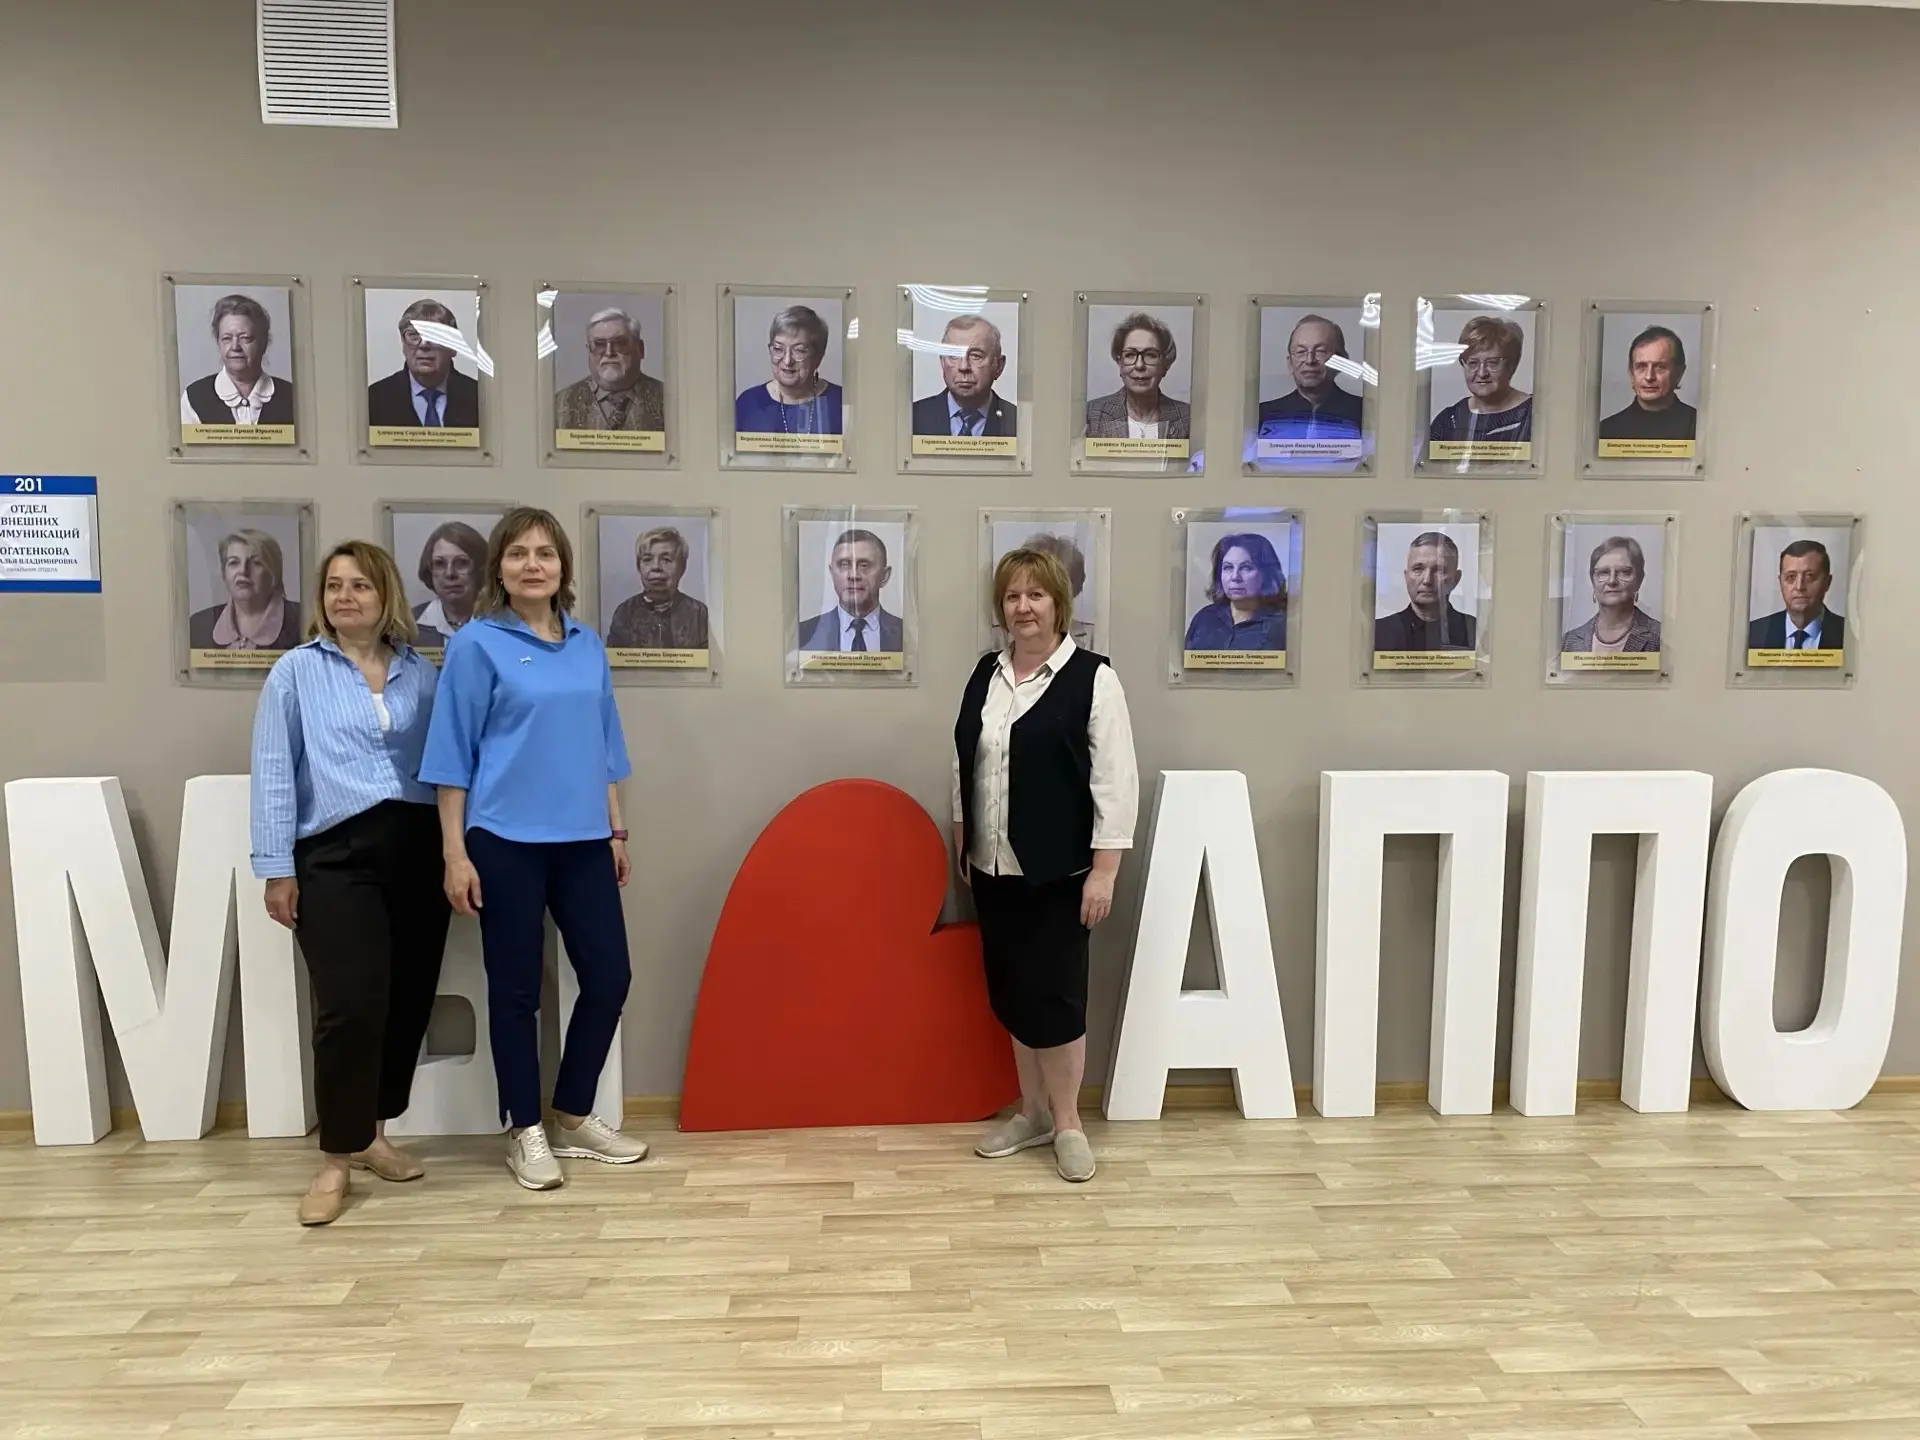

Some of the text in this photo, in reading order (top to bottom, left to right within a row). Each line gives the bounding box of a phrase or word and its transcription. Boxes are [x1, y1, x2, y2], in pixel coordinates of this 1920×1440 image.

[15, 478, 42, 492] 201
[10, 504, 48, 514] ОТДЕЛ
[1, 517, 59, 526] ВНЕШНИХ
[0, 546, 70, 555] ОГАТЕНКОВА
[1103, 767, 1908, 1122] АППО
